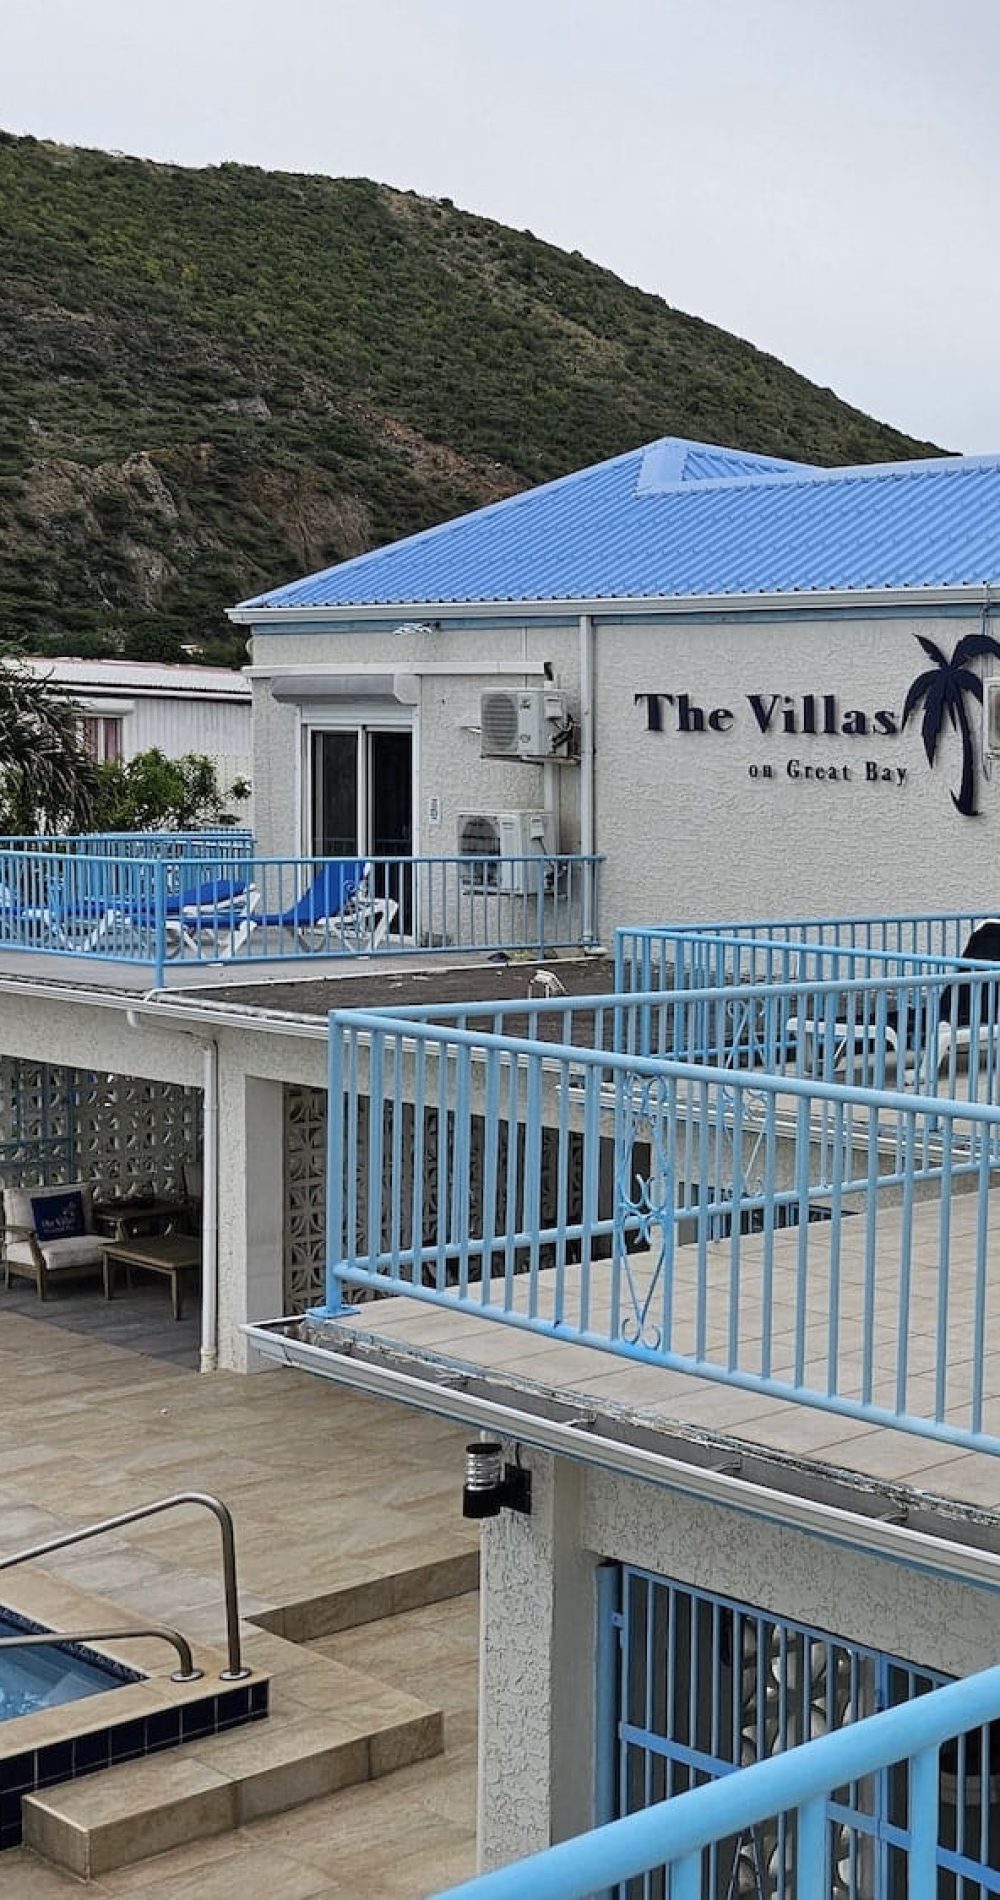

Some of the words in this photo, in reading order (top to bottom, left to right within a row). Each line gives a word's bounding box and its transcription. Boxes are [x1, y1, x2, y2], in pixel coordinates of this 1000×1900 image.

[634, 693, 734, 733] The
[746, 693, 902, 737] Villas
[749, 764, 773, 779] on
[786, 759, 851, 782] Great
[865, 761, 908, 787] Bay
